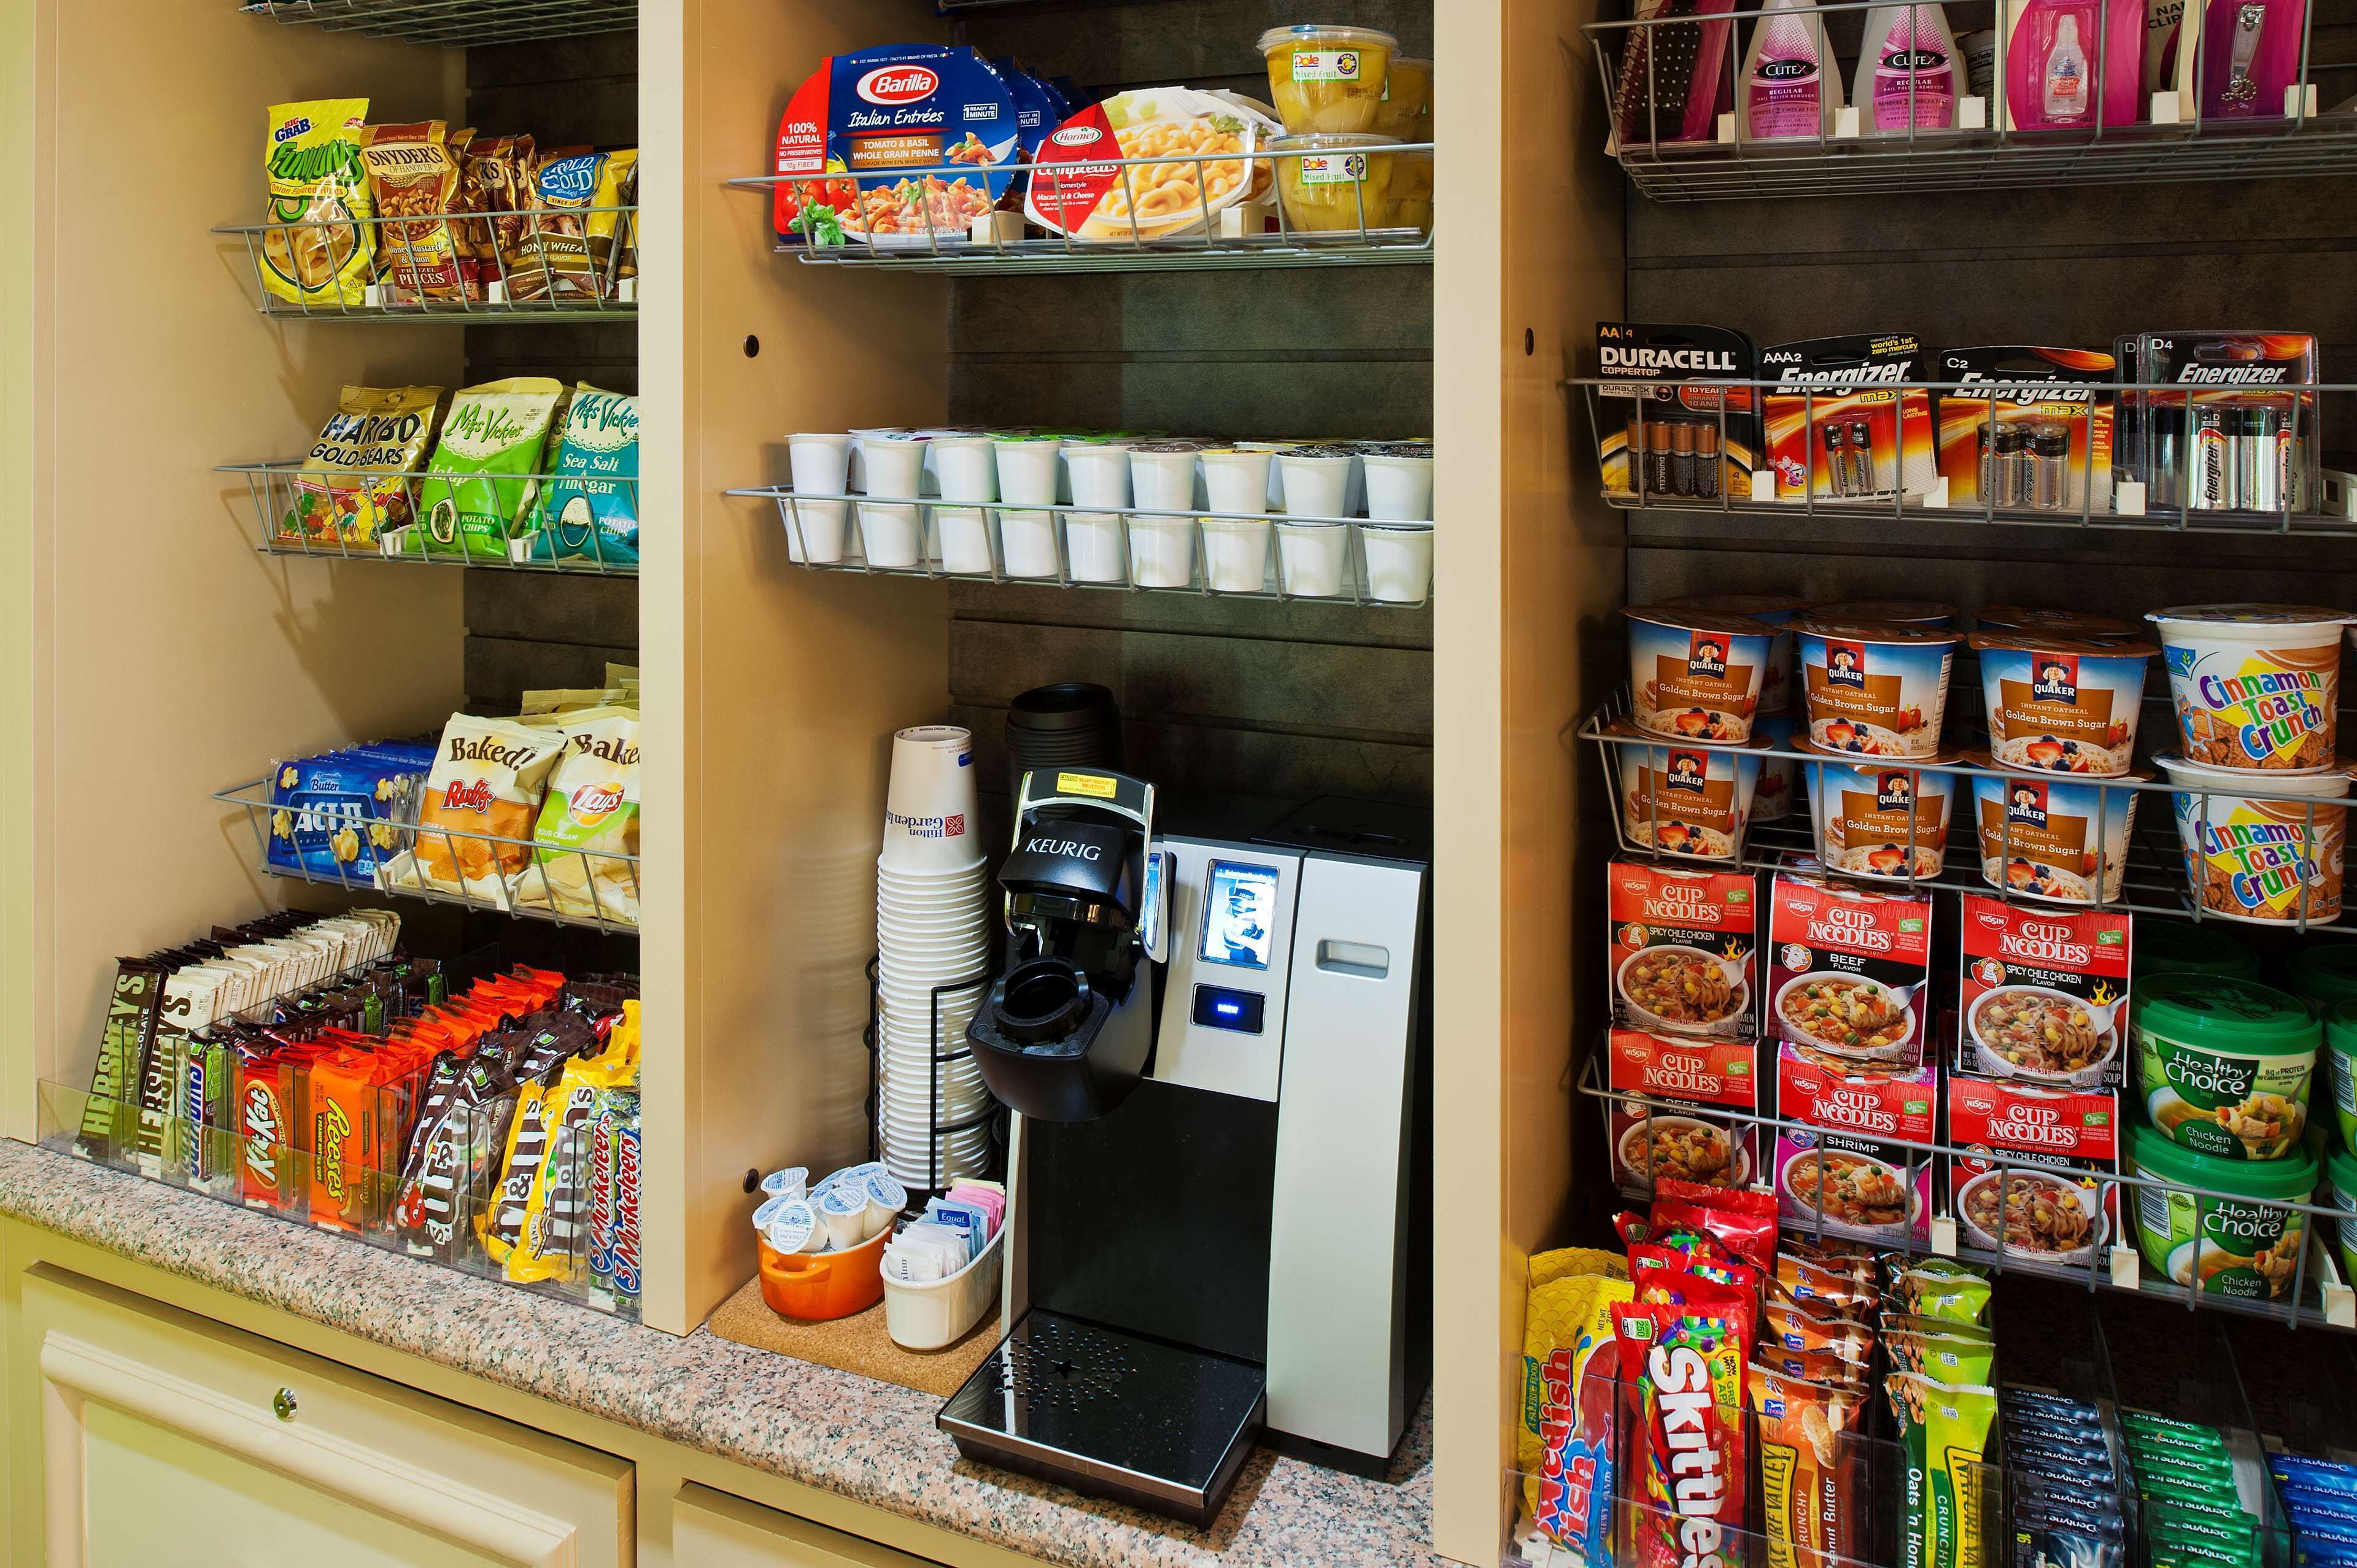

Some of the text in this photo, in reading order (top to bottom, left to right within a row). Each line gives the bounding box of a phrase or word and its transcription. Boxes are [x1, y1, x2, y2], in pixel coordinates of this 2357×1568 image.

[1295, 55, 1319, 66] Dole
[1766, 63, 1807, 76] CUTEX
[875, 74, 932, 94] Barilla
[285, 117, 299, 128] BIG
[848, 109, 945, 128] Italian Entrées
[969, 110, 996, 118] MINUTE
[275, 118, 311, 142] GRAB
[788, 122, 818, 134] 100%
[1059, 131, 1096, 141] Hormel
[782, 134, 821, 145] NATURAL
[864, 140, 897, 150] TOMATO
[907, 138, 929, 148] BASIL
[367, 145, 443, 166] SNYDER'S
[853, 148, 940, 160] WHOLE GRAIN PENNE
[399, 164, 433, 172] HANOVER
[551, 156, 595, 175] ROLD
[1302, 157, 1327, 169] Dole
[541, 169, 593, 191] GOLD
[271, 184, 291, 195] Onion
[410, 242, 441, 252] Mustard
[1871, 339, 1898, 349] world's
[1871, 342, 1918, 355] zero mercury
[1601, 347, 1736, 370] DURACELL
[1601, 366, 1660, 376] COPPERTOP
[1776, 361, 1911, 396] Energizer
[2177, 363, 2286, 385] Energizer
[567, 394, 603, 430] Miss
[321, 412, 421, 446] HARIBO
[444, 403, 484, 440] Miss
[310, 443, 404, 467] GOLD-BEARS
[563, 453, 619, 472] Sea Salt
[462, 515, 495, 525] POTATO
[463, 523, 490, 532] CHIPS
[598, 516, 638, 528] POTATO
[600, 526, 629, 538] CHIPS
[1690, 660, 1724, 673] QUAKER
[1829, 668, 1863, 682] QUAKER
[1676, 677, 1703, 686] INSTANT
[1659, 683, 1690, 697] Golden
[1692, 689, 1720, 700] Brown
[1722, 692, 1745, 701] Sugar
[1845, 690, 1876, 699] OATMEAL
[2034, 684, 2075, 697] QUAKER
[2199, 670, 2322, 711] Cinnamon
[1811, 693, 1833, 706] Golden
[1835, 699, 1864, 711] Brown
[1866, 703, 1896, 714] Sugar
[2021, 702, 2051, 711] INSTANT
[2240, 690, 2308, 727] Toast
[2005, 709, 2038, 724] Golden
[2040, 716, 2075, 727] Brown
[2077, 719, 2107, 730] Sugar
[2239, 702, 2323, 761] Crunch
[449, 736, 538, 771] Baked!
[311, 779, 339, 792] Butter
[440, 777, 497, 814] Ruffles
[572, 784, 620, 815] Lay's
[294, 801, 338, 833] ACT
[895, 814, 943, 829] Garden
[538, 828, 578, 841] SOUR CREAM
[909, 829, 943, 838] Hilton
[1026, 838, 1101, 860] KEURIG
[2232, 841, 2300, 877] Toast
[1625, 881, 1647, 890] NISSIN
[1661, 885, 1704, 903] CUP
[1643, 898, 1722, 923] NOODLES
[1789, 902, 1813, 912] NISSIN
[1828, 908, 1875, 929] CUP
[1980, 914, 2004, 925] NISSIN
[1649, 927, 1714, 941] SPICY CHILE CHICKEN
[1808, 921, 1891, 951] NOODLES
[2021, 922, 2072, 943] CUP
[1825, 943, 1849, 952] Original
[2001, 934, 2089, 964] NOODLES
[1830, 953, 1866, 967] BEEF
[1833, 963, 1862, 973] FLAVOR
[2019, 957, 2045, 967] Original
[2007, 964, 2082, 984] SPICY CHILE CHICKEN
[2032, 978, 2056, 987] FLAVOR
[1902, 1054, 1918, 1063] SOUP
[2173, 1051, 2252, 1081] Healthy
[2165, 1062, 2248, 1095] Choice
[246, 1089, 276, 1183] Kit Kat
[1827, 1135, 1879, 1153] SHRIMP
[2186, 1126, 2231, 1145] Chicken
[326, 1097, 351, 1203] Reese's
[2189, 1137, 2229, 1154] Noodle
[2038, 1155, 2070, 1167] CHICKEN
[590, 1113, 611, 1248] Musketeers
[615, 1134, 640, 1290] 3 Musketeers
[2215, 1201, 2289, 1223] Healthy
[2203, 1212, 2281, 1238] Choice
[2221, 1274, 2262, 1288] Chicken
[2223, 1285, 2258, 1297] Noodle
[1636, 1321, 1645, 1337] 250
[2160, 1456, 2207, 1471] Dentyne
[2302, 1458, 2348, 1472] Dentyne
[1763, 1443, 1791, 1512] VALLEY
[2165, 1477, 2213, 1493] Dentyne
[1908, 1467, 1922, 1506] Oats
[1823, 1477, 1836, 1524] Butter
[1600, 1507, 1609, 1540] CHEWY
[1797, 1489, 1810, 1549] CRUNCHY
